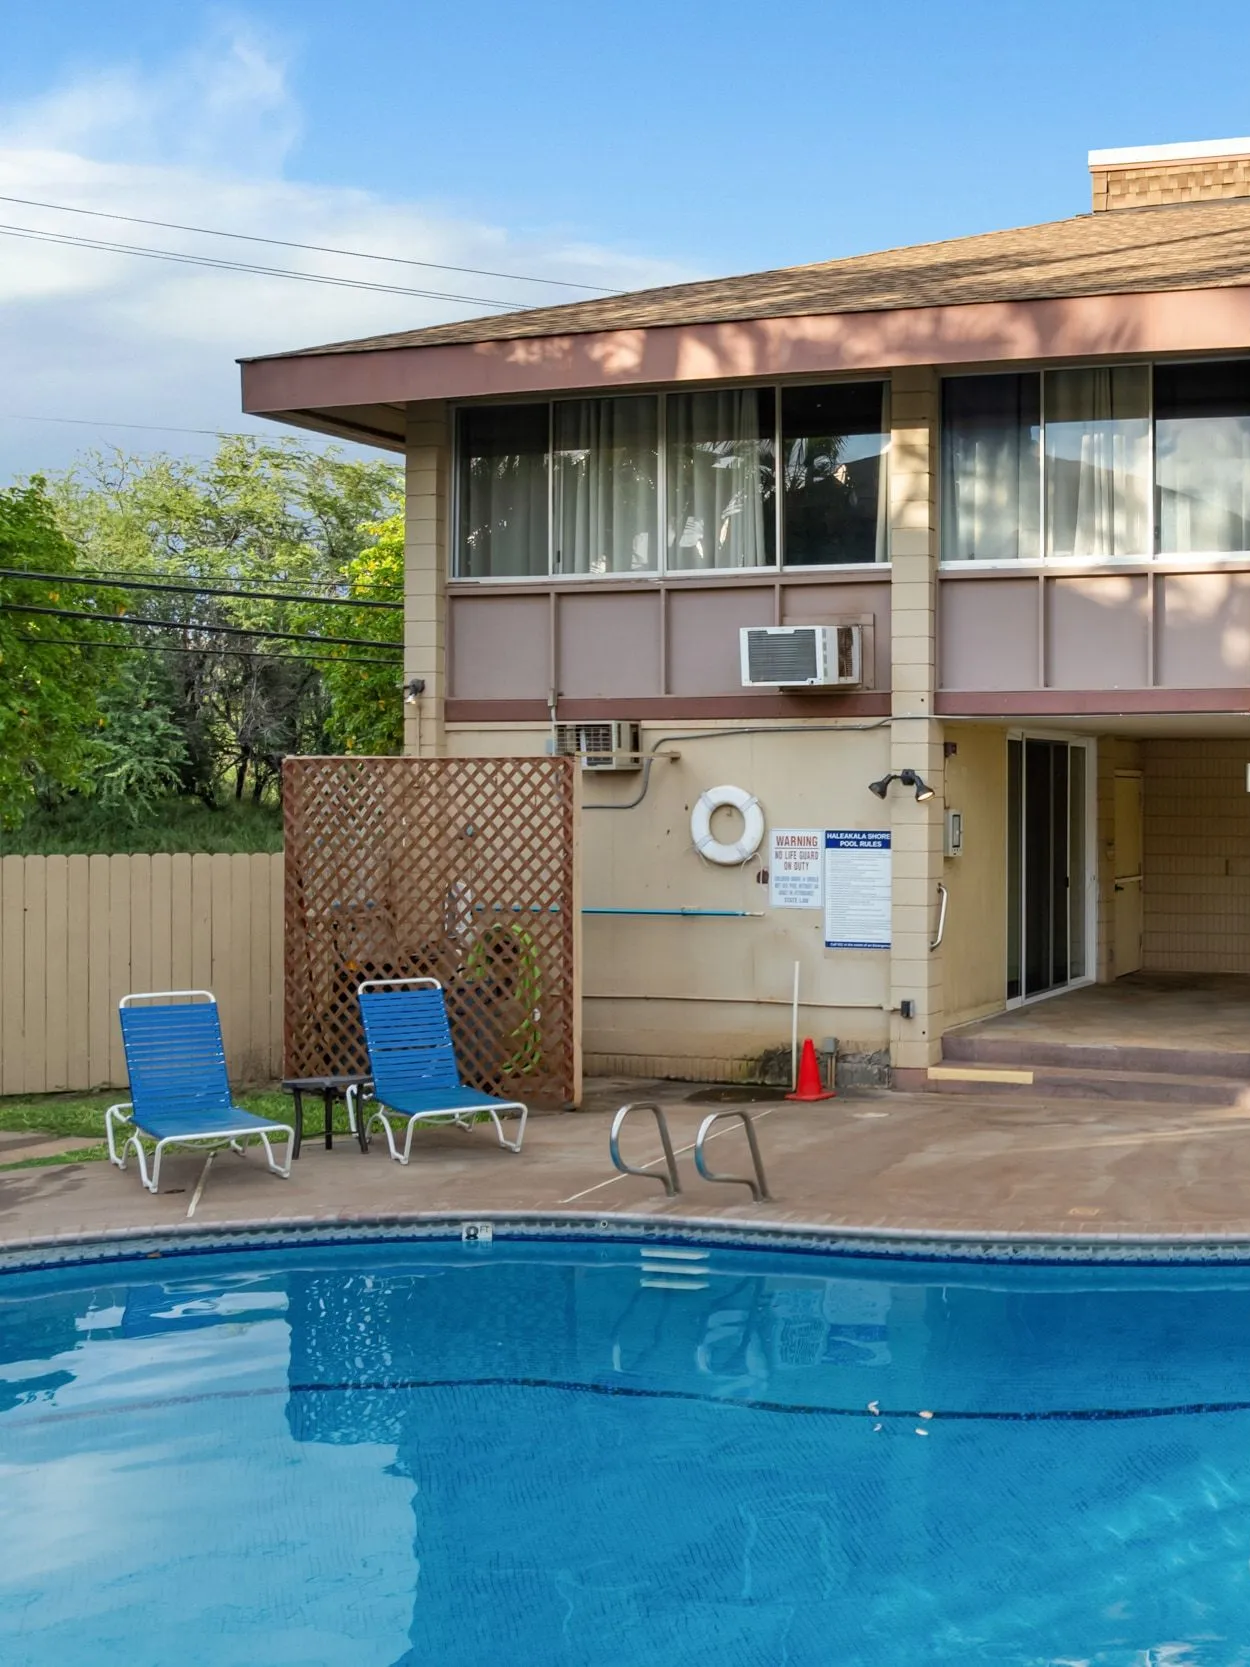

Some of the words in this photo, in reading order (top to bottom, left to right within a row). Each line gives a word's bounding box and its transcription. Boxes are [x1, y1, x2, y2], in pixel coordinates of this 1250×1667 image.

[776, 835, 818, 847] WARNING
[840, 840, 859, 848] POOL
[860, 840, 882, 848] RULES
[775, 850, 783, 860] NO
[784, 850, 797, 860] LIFE
[799, 850, 819, 860] GUARD
[784, 861, 792, 871] ON
[794, 861, 809, 871] DUTY
[465, 1225, 479, 1241] 8
[480, 1225, 490, 1233] FT
